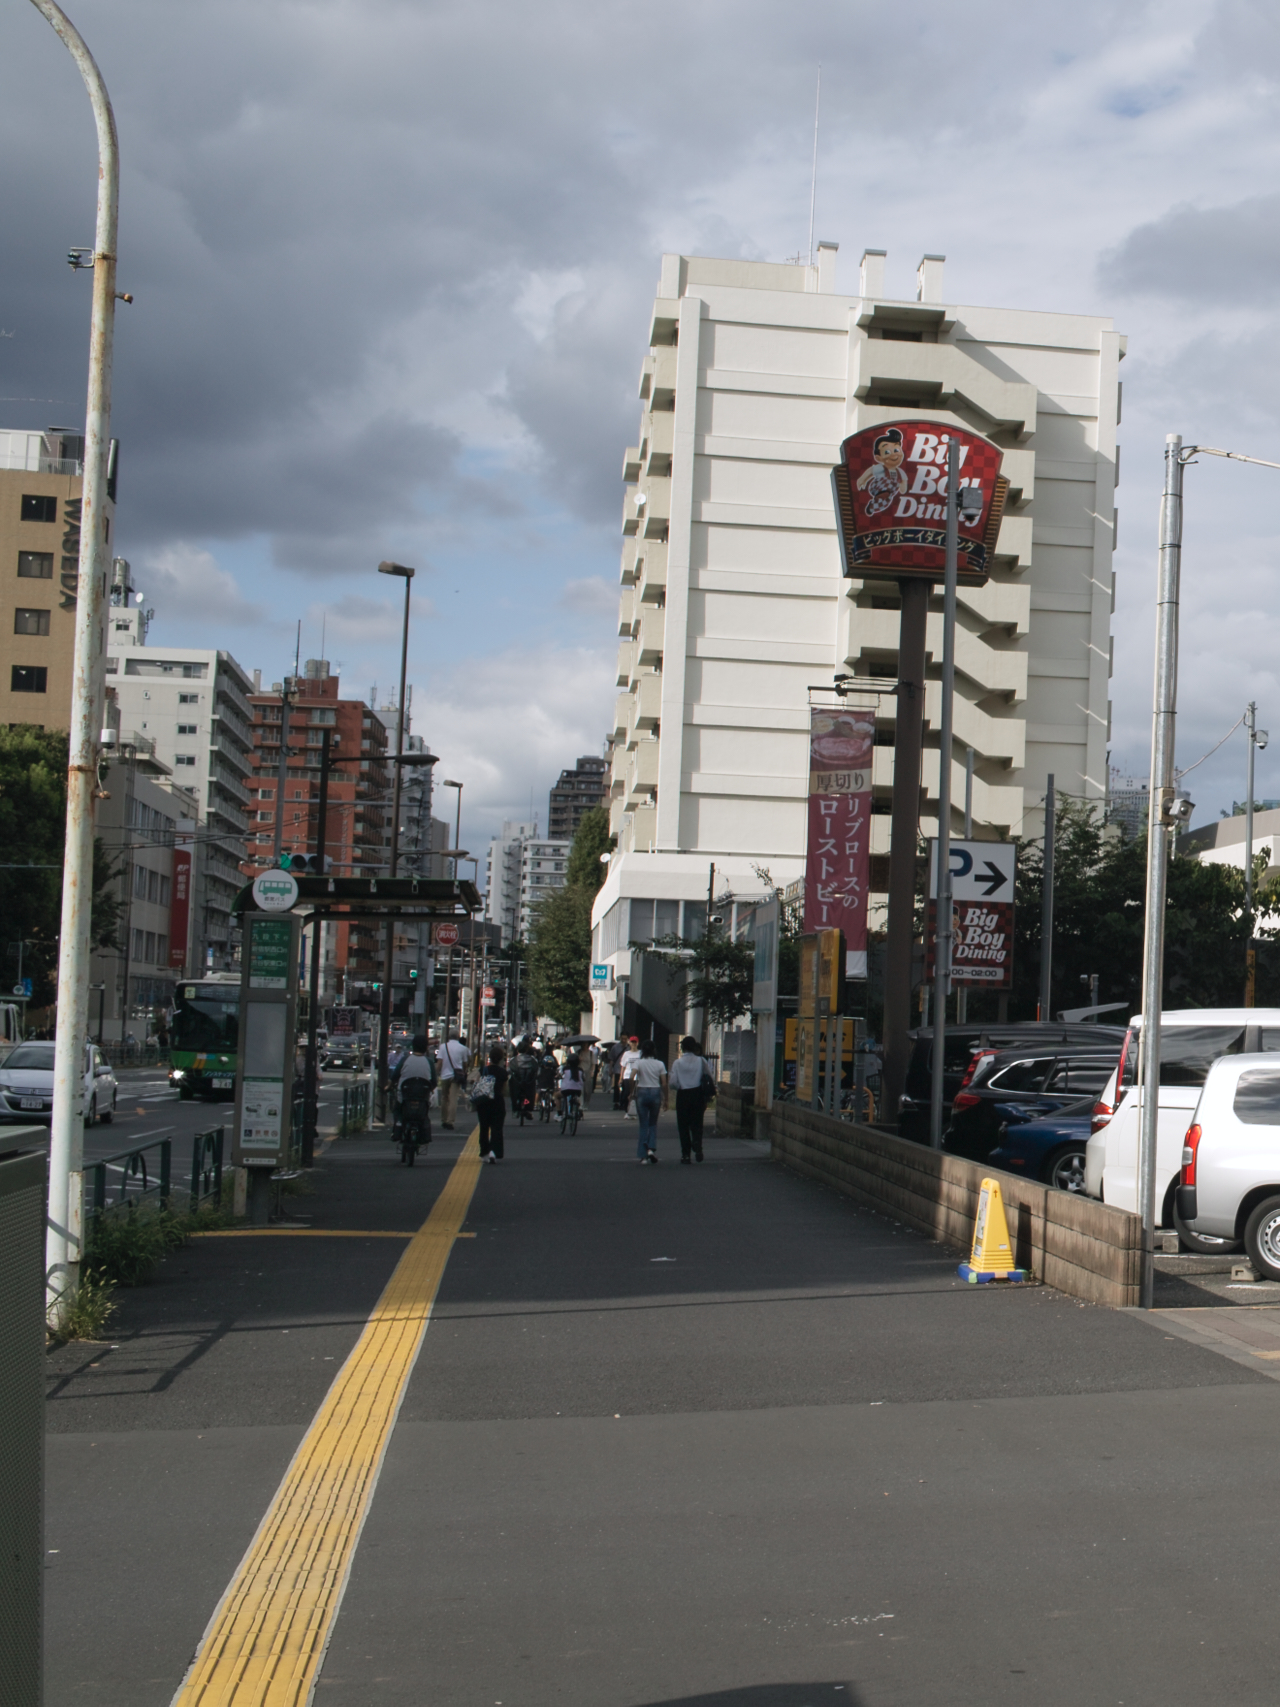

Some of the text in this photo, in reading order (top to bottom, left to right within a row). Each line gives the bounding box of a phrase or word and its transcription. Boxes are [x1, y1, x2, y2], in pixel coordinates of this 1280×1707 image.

[863, 529, 977, 553] ビッグボーイダイング
[815, 771, 865, 793] 厚切り
[841, 795, 864, 910] リブロースの
[813, 798, 838, 932] ローストビー
[963, 907, 999, 932] Big
[964, 926, 1006, 950] Boy
[955, 944, 1007, 963] Dining
